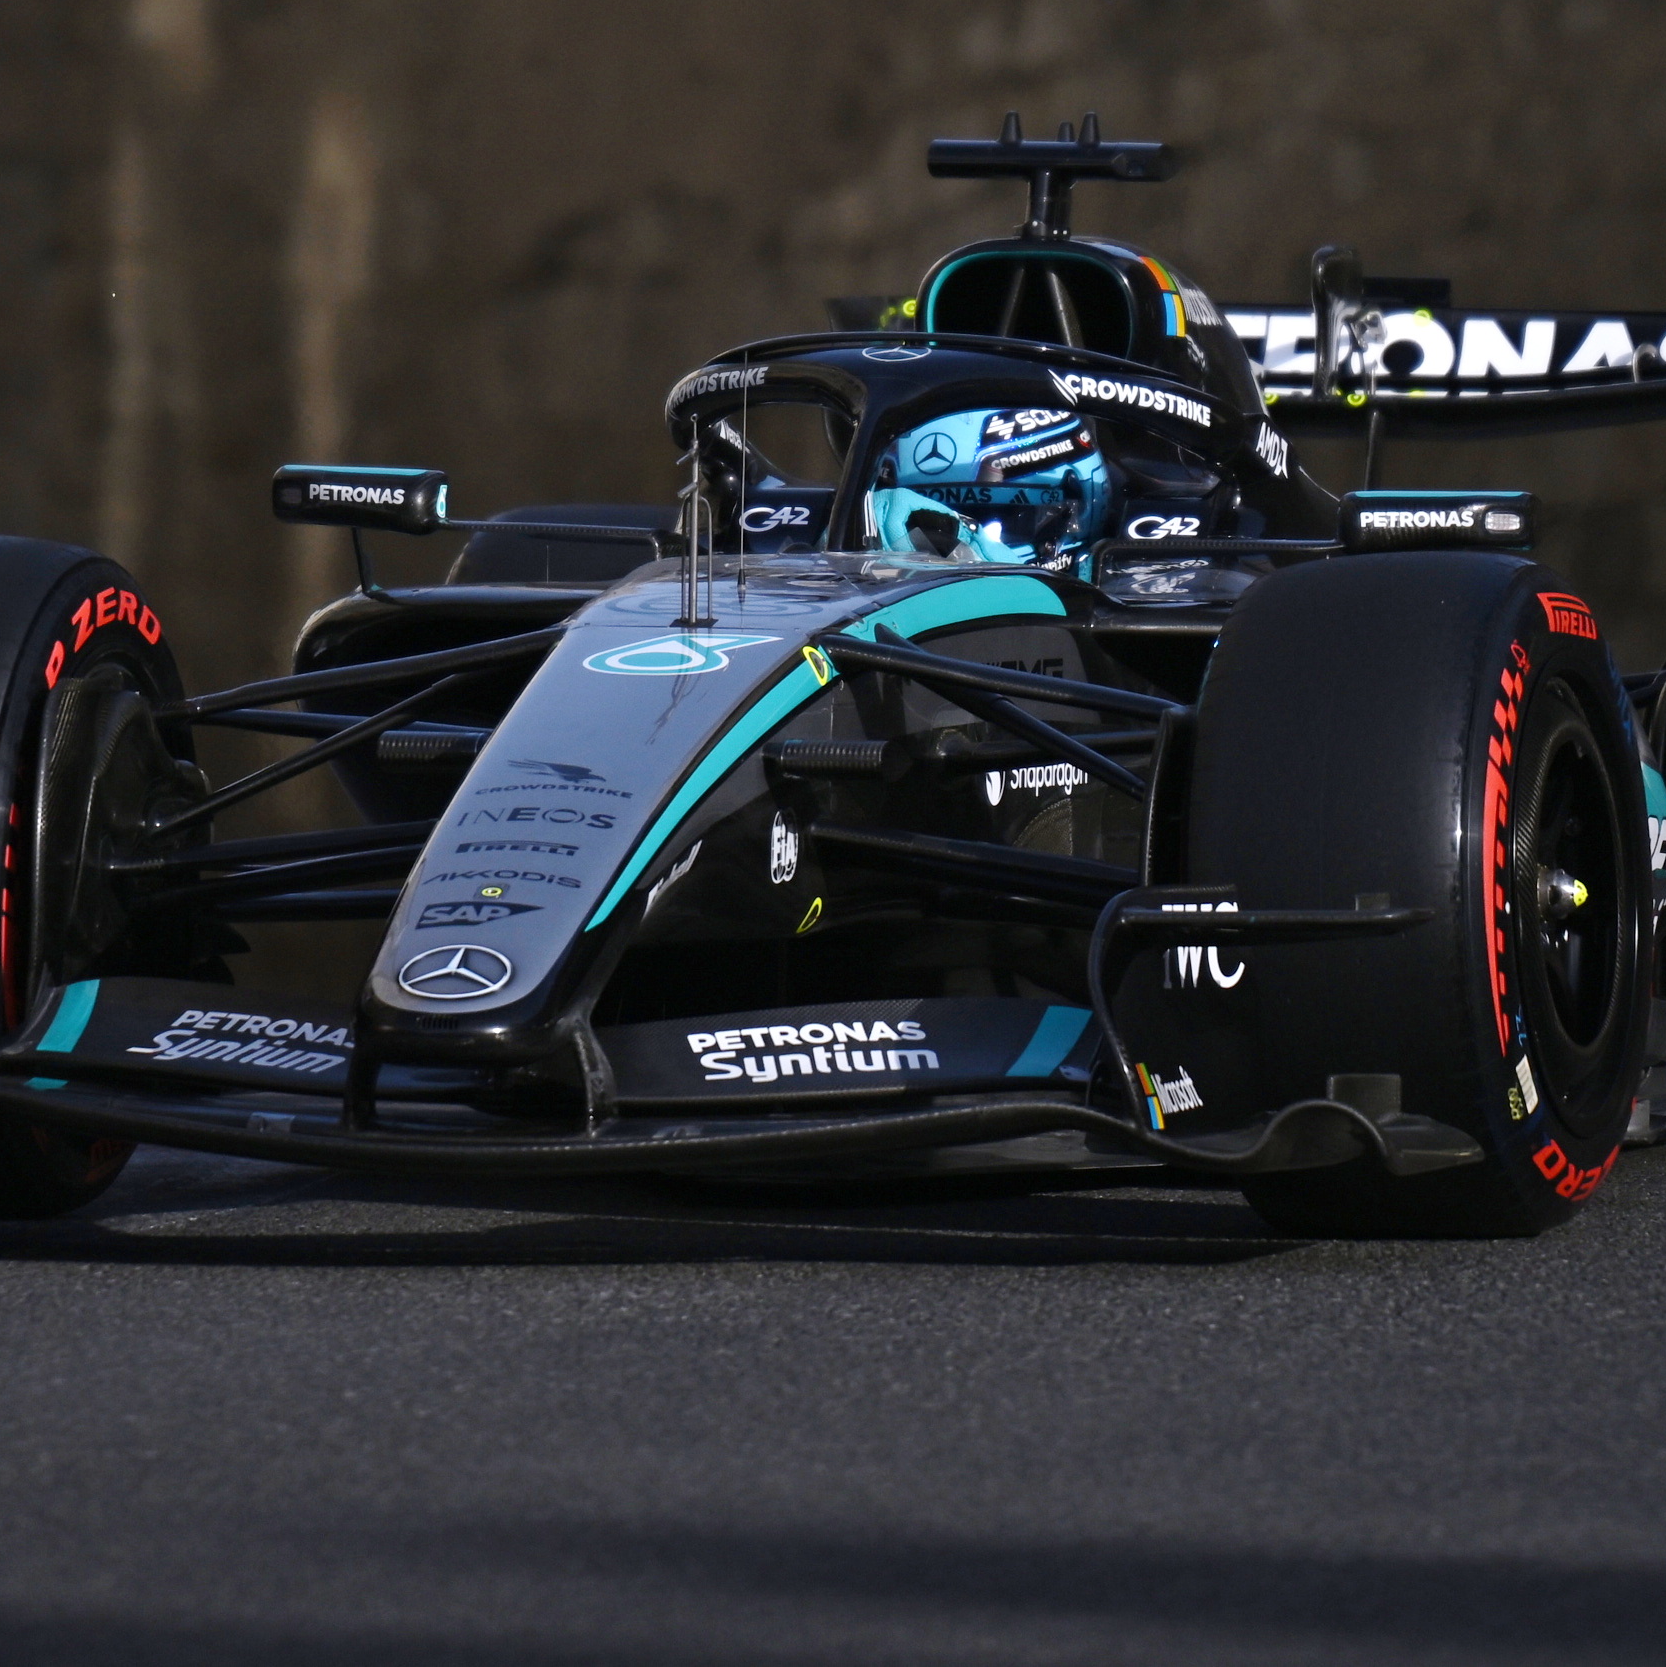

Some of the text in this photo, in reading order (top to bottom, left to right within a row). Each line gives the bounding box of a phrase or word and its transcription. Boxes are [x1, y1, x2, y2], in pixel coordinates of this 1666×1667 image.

[1064, 374, 1211, 428] CROWDSTRIKE
[991, 439, 1075, 470] CROWDSTRIKE
[1256, 422, 1283, 471] AMD
[309, 483, 406, 505] PETRONAS
[739, 506, 811, 532] G42
[1128, 515, 1201, 540] G42
[1360, 511, 1474, 528] PETRONAS
[71, 586, 162, 653] ZERO
[1536, 592, 1598, 640] PIRELLI
[474, 784, 633, 800] CROWDSTRIKE
[456, 807, 617, 830] INEOS
[454, 839, 580, 857] PIRELLI
[420, 905, 514, 924] SAP
[171, 1009, 356, 1049] PETRONA
[687, 1020, 926, 1053] PETRONAS
[125, 1029, 346, 1074] Syntium
[700, 1043, 939, 1083] Syntium
